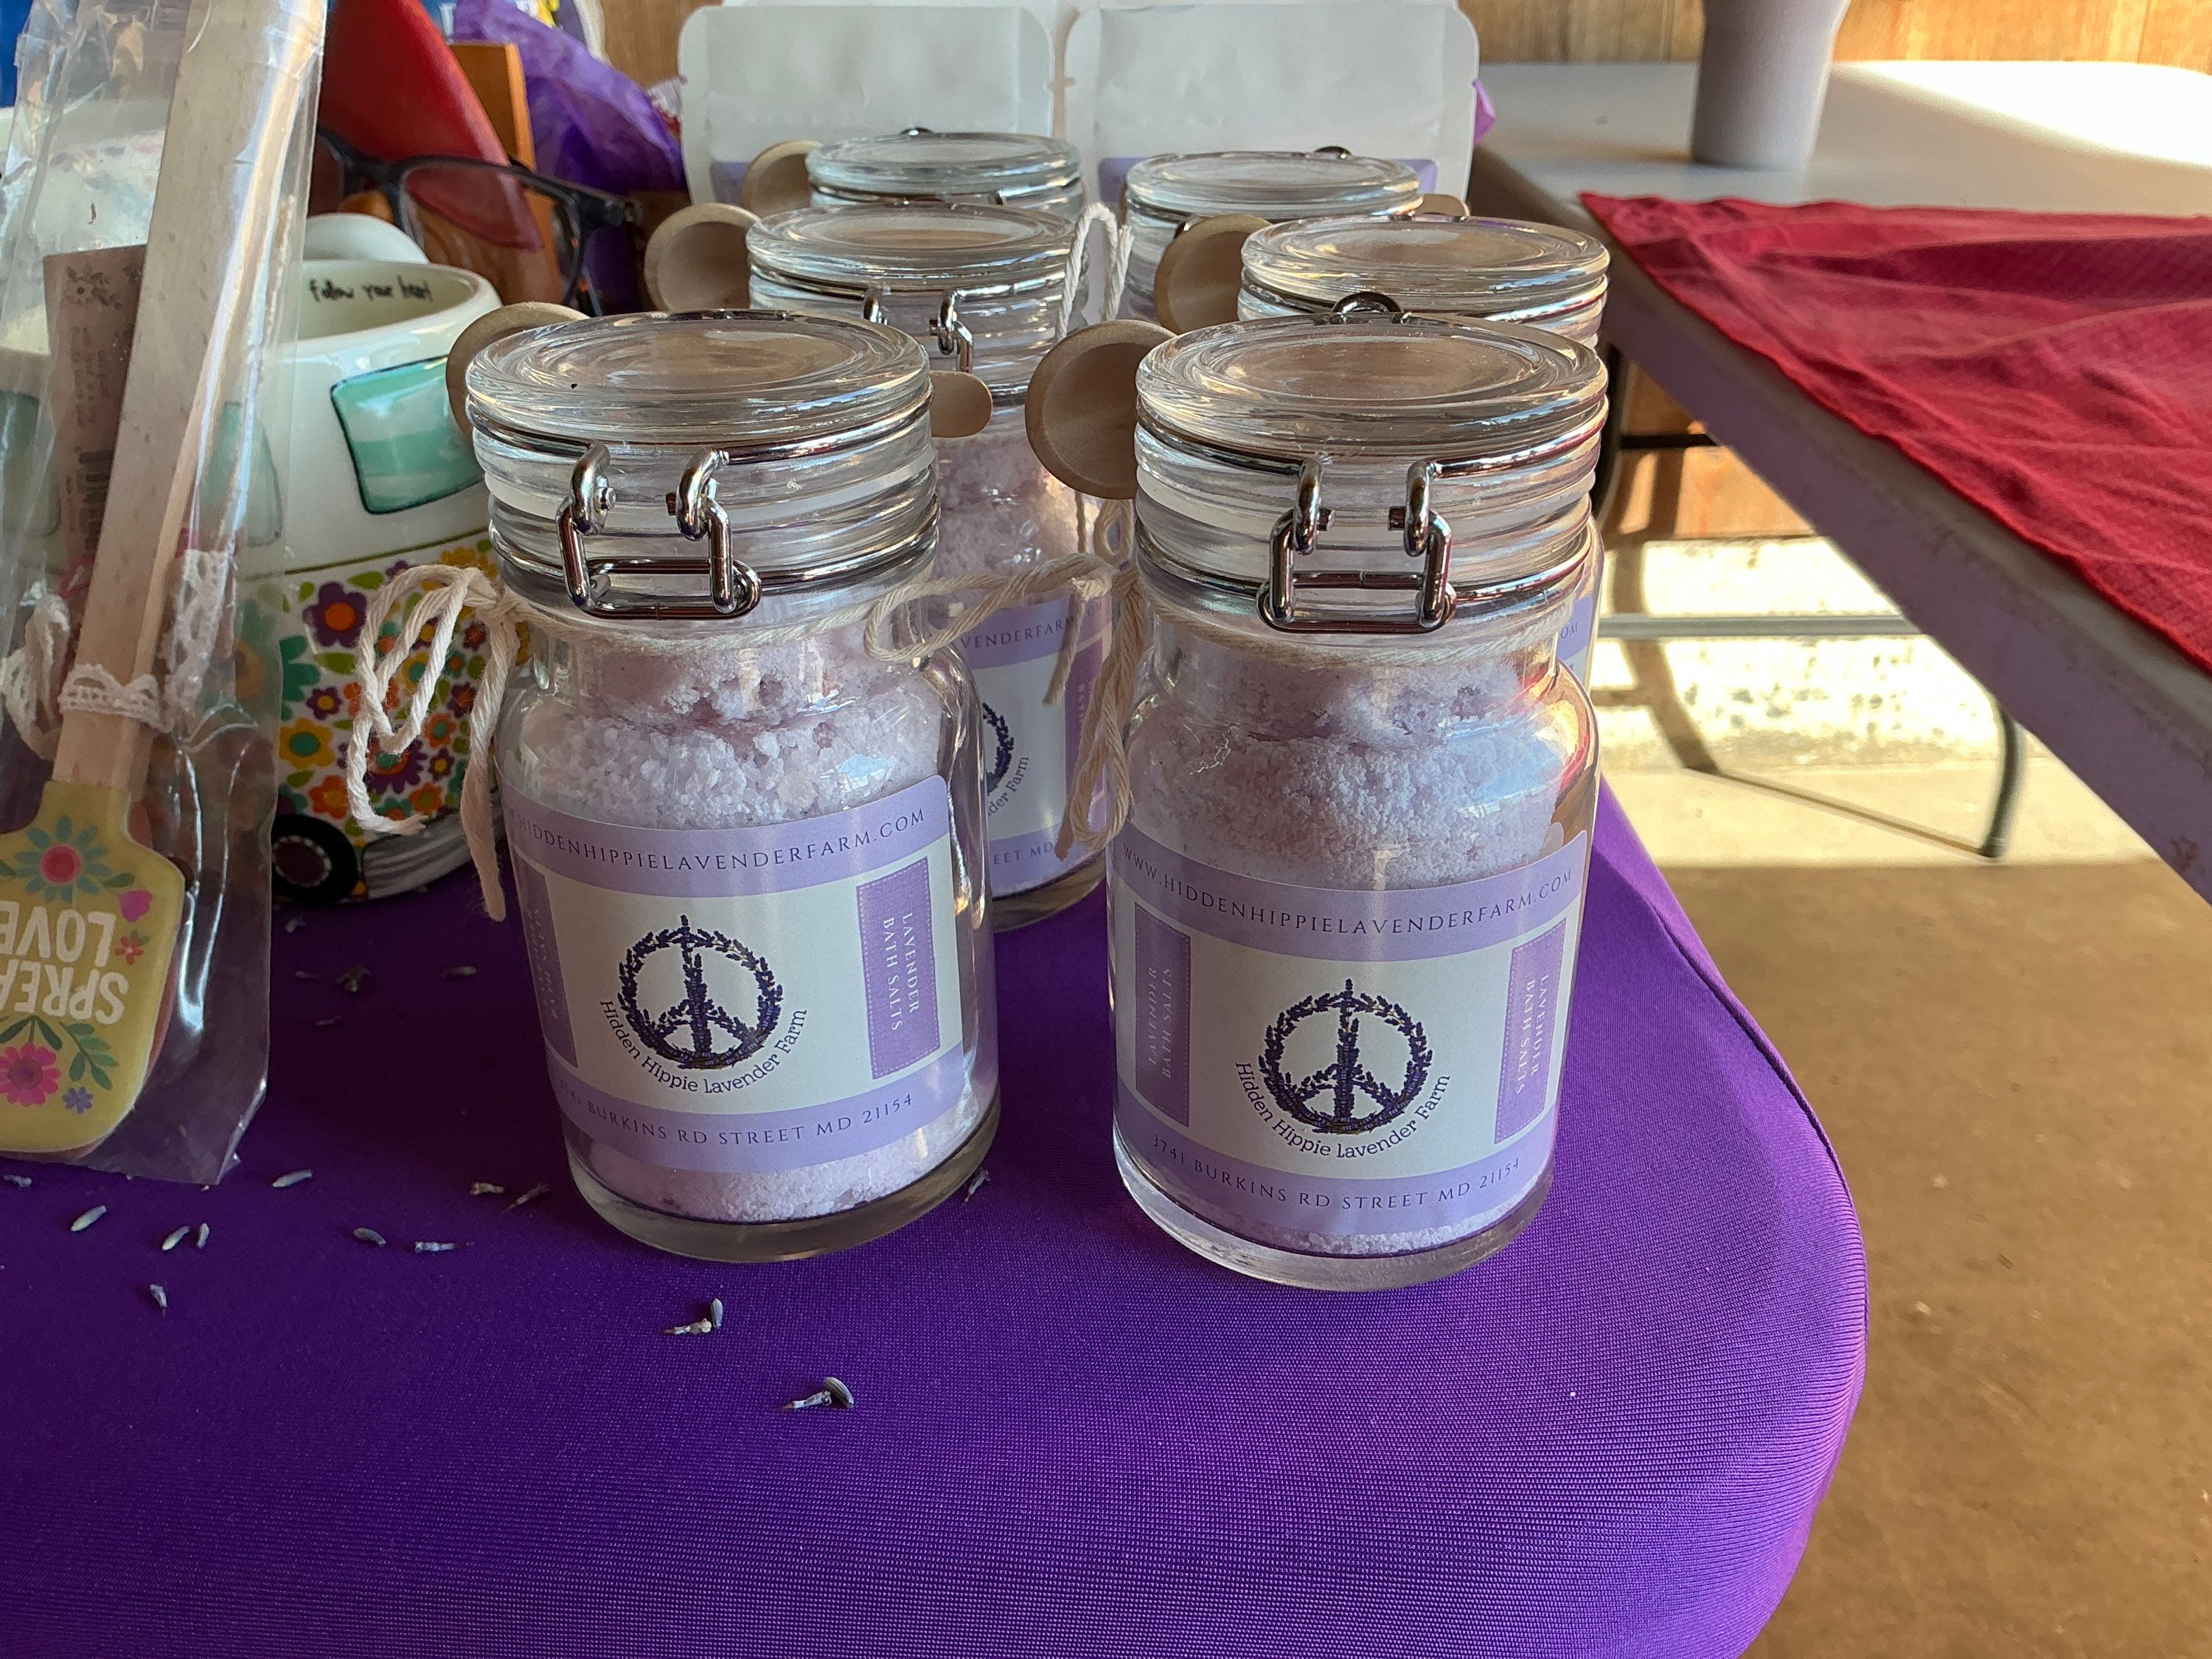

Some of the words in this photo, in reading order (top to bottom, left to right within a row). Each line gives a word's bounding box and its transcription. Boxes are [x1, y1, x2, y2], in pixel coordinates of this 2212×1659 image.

[1006, 756, 1029, 793] Farm
[1030, 842, 1054, 858] MD
[1123, 843, 1571, 934] WWW.HIDDENHIPPIELAVENDERFARM.COM
[0, 900, 116, 967] LOVE
[883, 917, 898, 968] BATH
[902, 912, 920, 1013] LAVENDER
[888, 974, 903, 1032] SALTS
[1148, 967, 1157, 1065] LAVENDER
[1162, 967, 1172, 1023] SALTS
[1522, 979, 1535, 1031] BATH
[600, 1000, 641, 1061] Hidden
[641, 1056, 699, 1093] Hippie
[774, 1009, 808, 1054] Farm
[1162, 1030, 1172, 1079] BATH
[1531, 974, 1549, 1077] LAVENDER
[1516, 1037, 1530, 1093] SALTS
[588, 1100, 667, 1139] BURKINS
[678, 1129, 707, 1144] RD
[719, 1126, 804, 1145] STREET
[816, 1117, 852, 1135] MD
[862, 1093, 912, 1124] 21154
[1235, 1062, 1273, 1122] Hidden
[1272, 1119, 1331, 1156] Hippie
[1414, 1074, 1450, 1119] Farm
[1152, 1134, 1184, 1164] 3741
[1194, 1159, 1287, 1202] BURKINS
[1299, 1192, 1330, 1207] RD
[1342, 1192, 1427, 1209] STREET
[1439, 1182, 1470, 1201] MD
[1480, 1158, 1520, 1189] 21154
